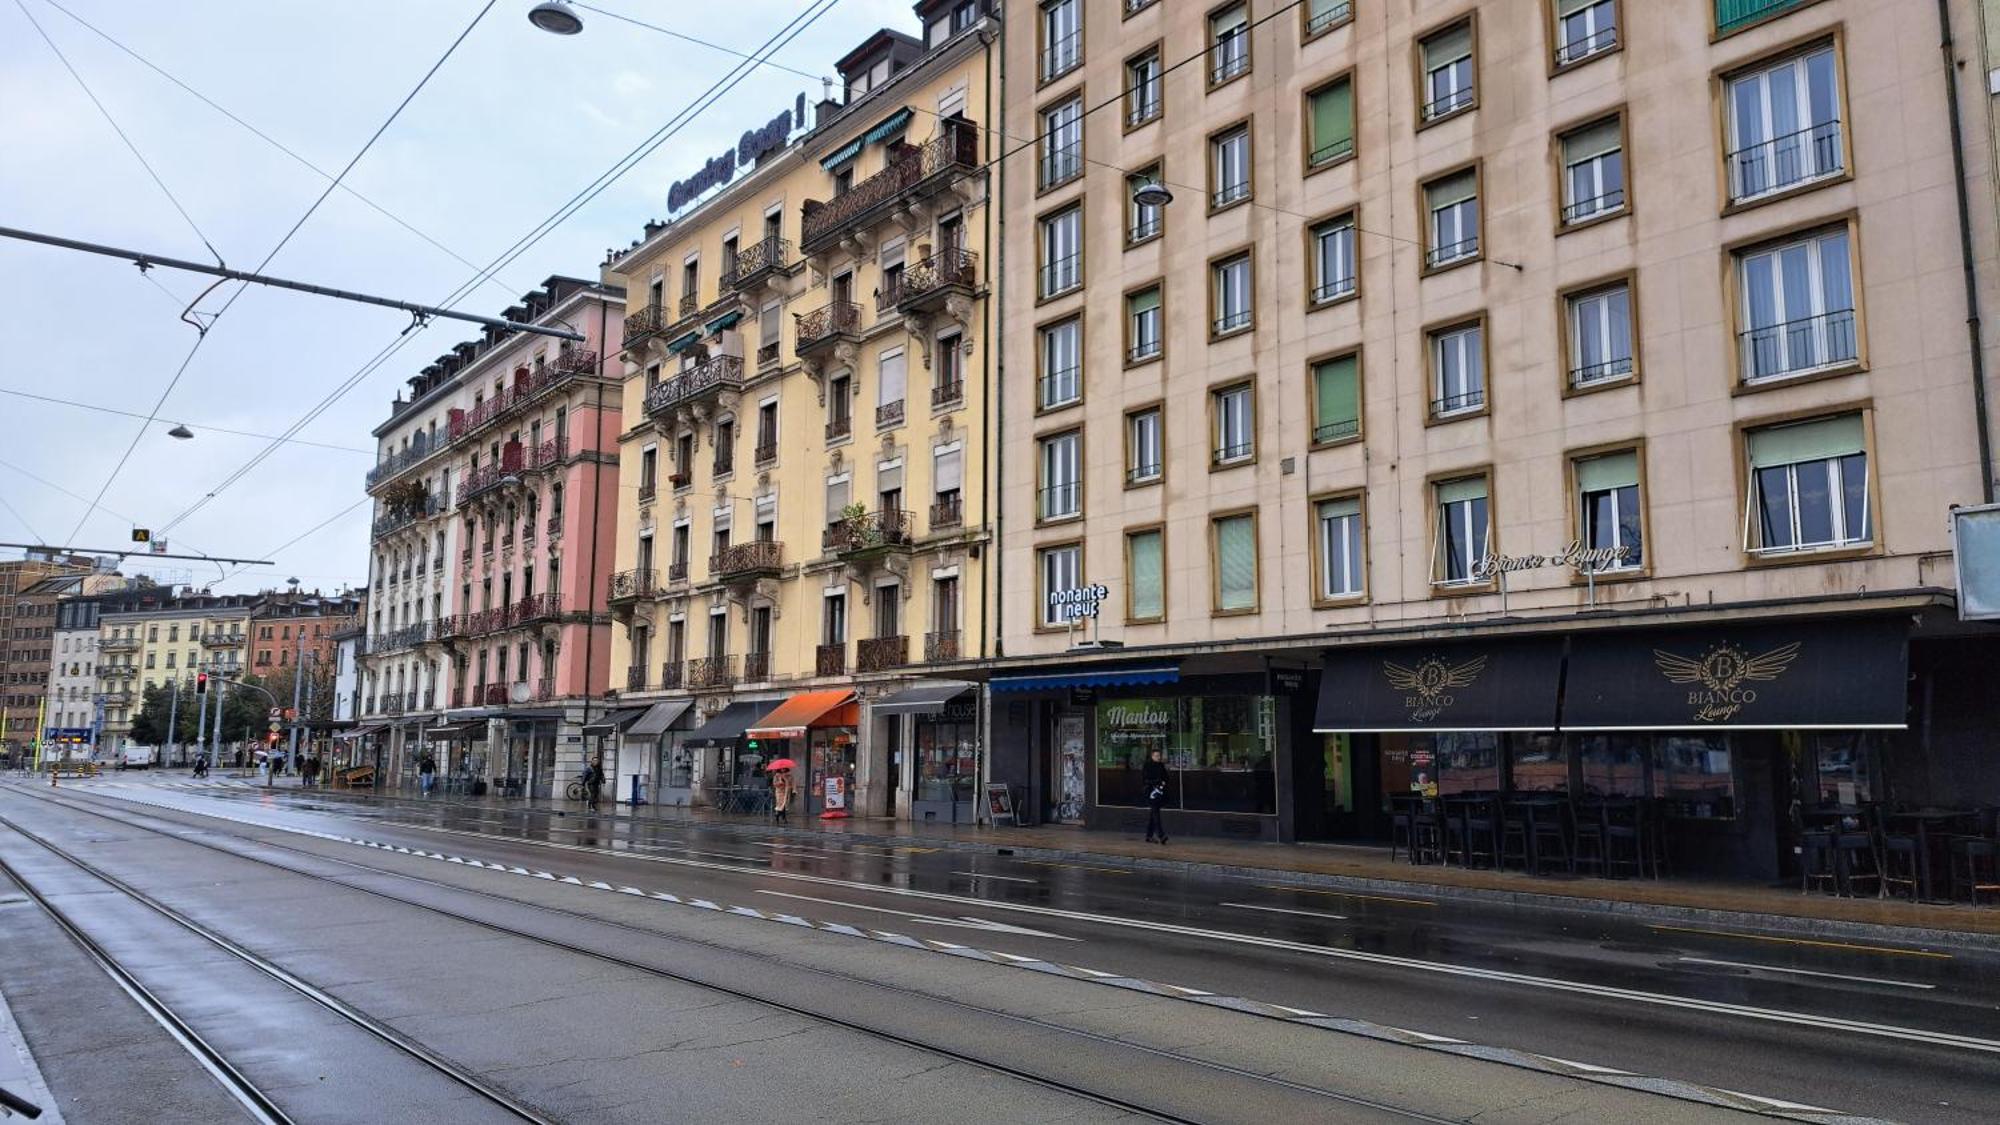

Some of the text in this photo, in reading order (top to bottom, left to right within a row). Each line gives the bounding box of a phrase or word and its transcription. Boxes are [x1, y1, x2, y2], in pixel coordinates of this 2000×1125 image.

[1471, 539, 1630, 577] Bianco Lounge
[1050, 584, 1107, 605] nonante
[1066, 601, 1098, 618] neuf
[1426, 667, 1438, 686] B
[1715, 656, 1732, 678] B
[1405, 695, 1454, 708] BIANCO
[1688, 689, 1757, 704] BIANCO
[1107, 705, 1169, 728] Mantou
[1408, 706, 1441, 722] Lounge
[1693, 703, 1742, 722] Lounge
